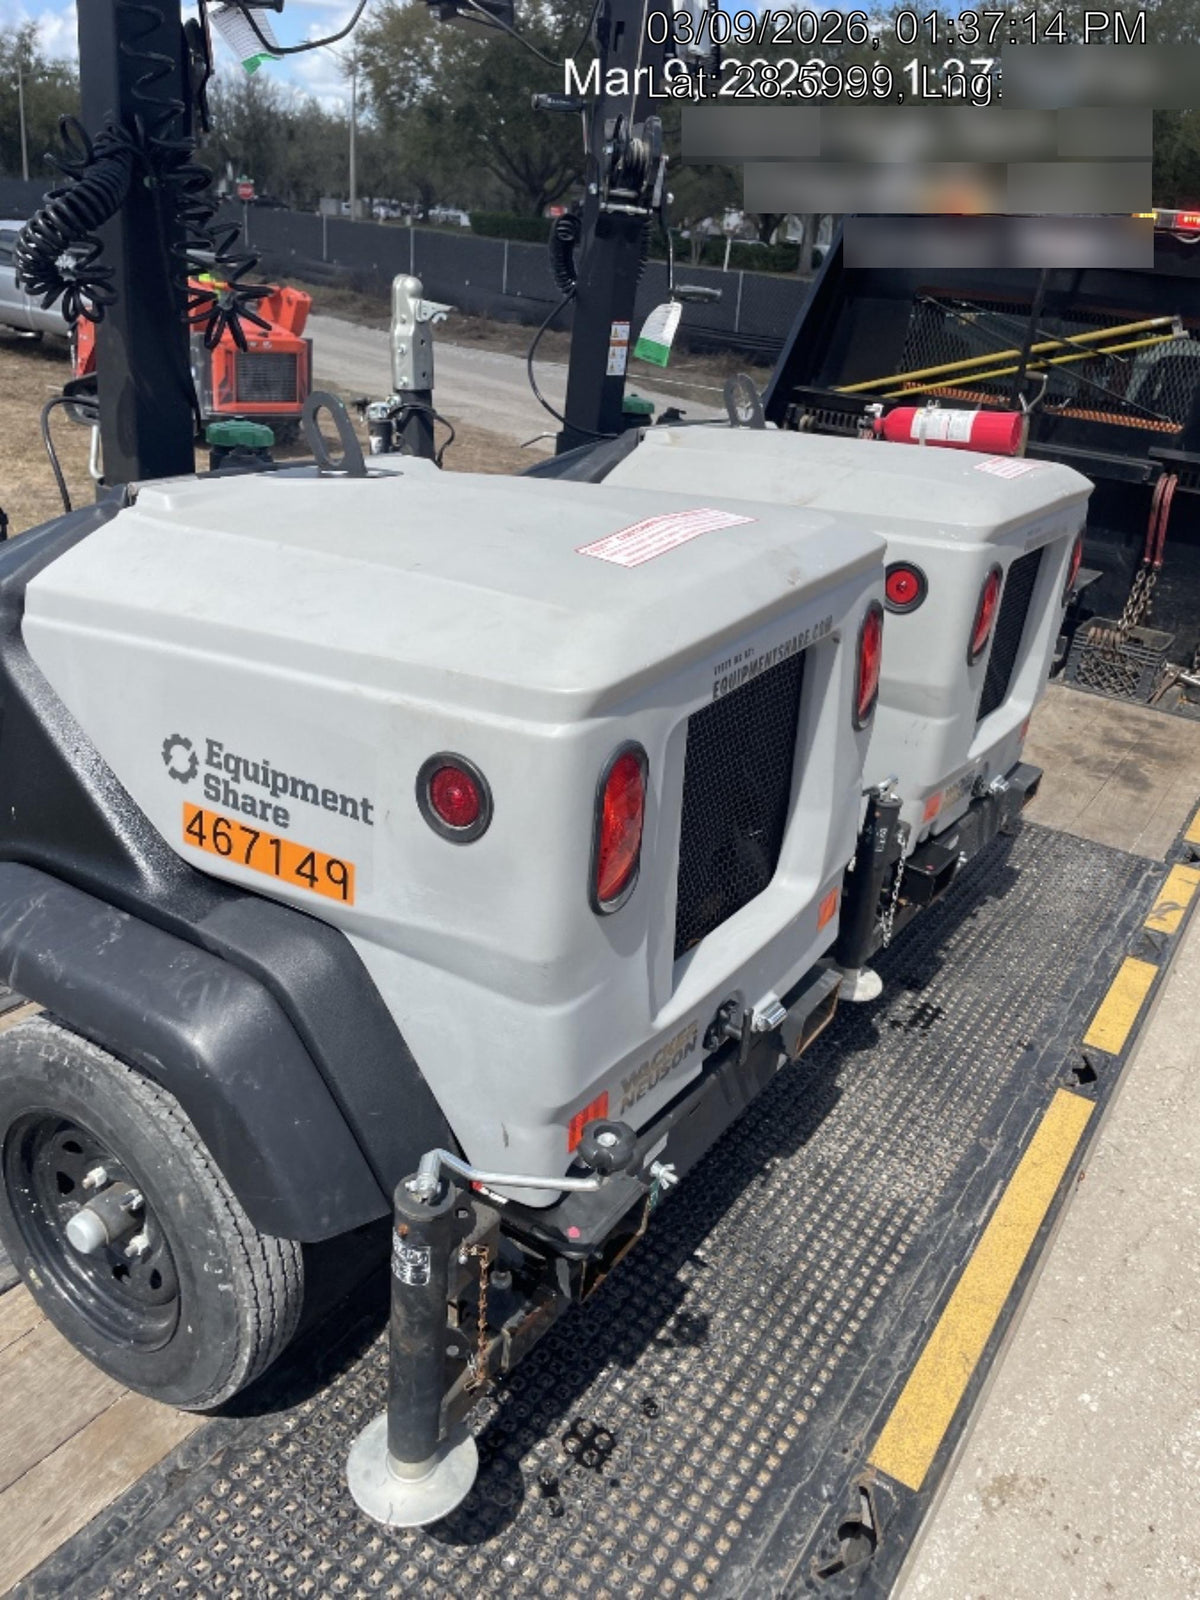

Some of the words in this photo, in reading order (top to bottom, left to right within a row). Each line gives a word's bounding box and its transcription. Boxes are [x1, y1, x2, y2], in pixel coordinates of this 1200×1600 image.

[203, 772, 290, 829] Share
[205, 737, 374, 826] Equipment
[186, 810, 349, 900] 467149
[620, 1034, 698, 1115] NEUSON
